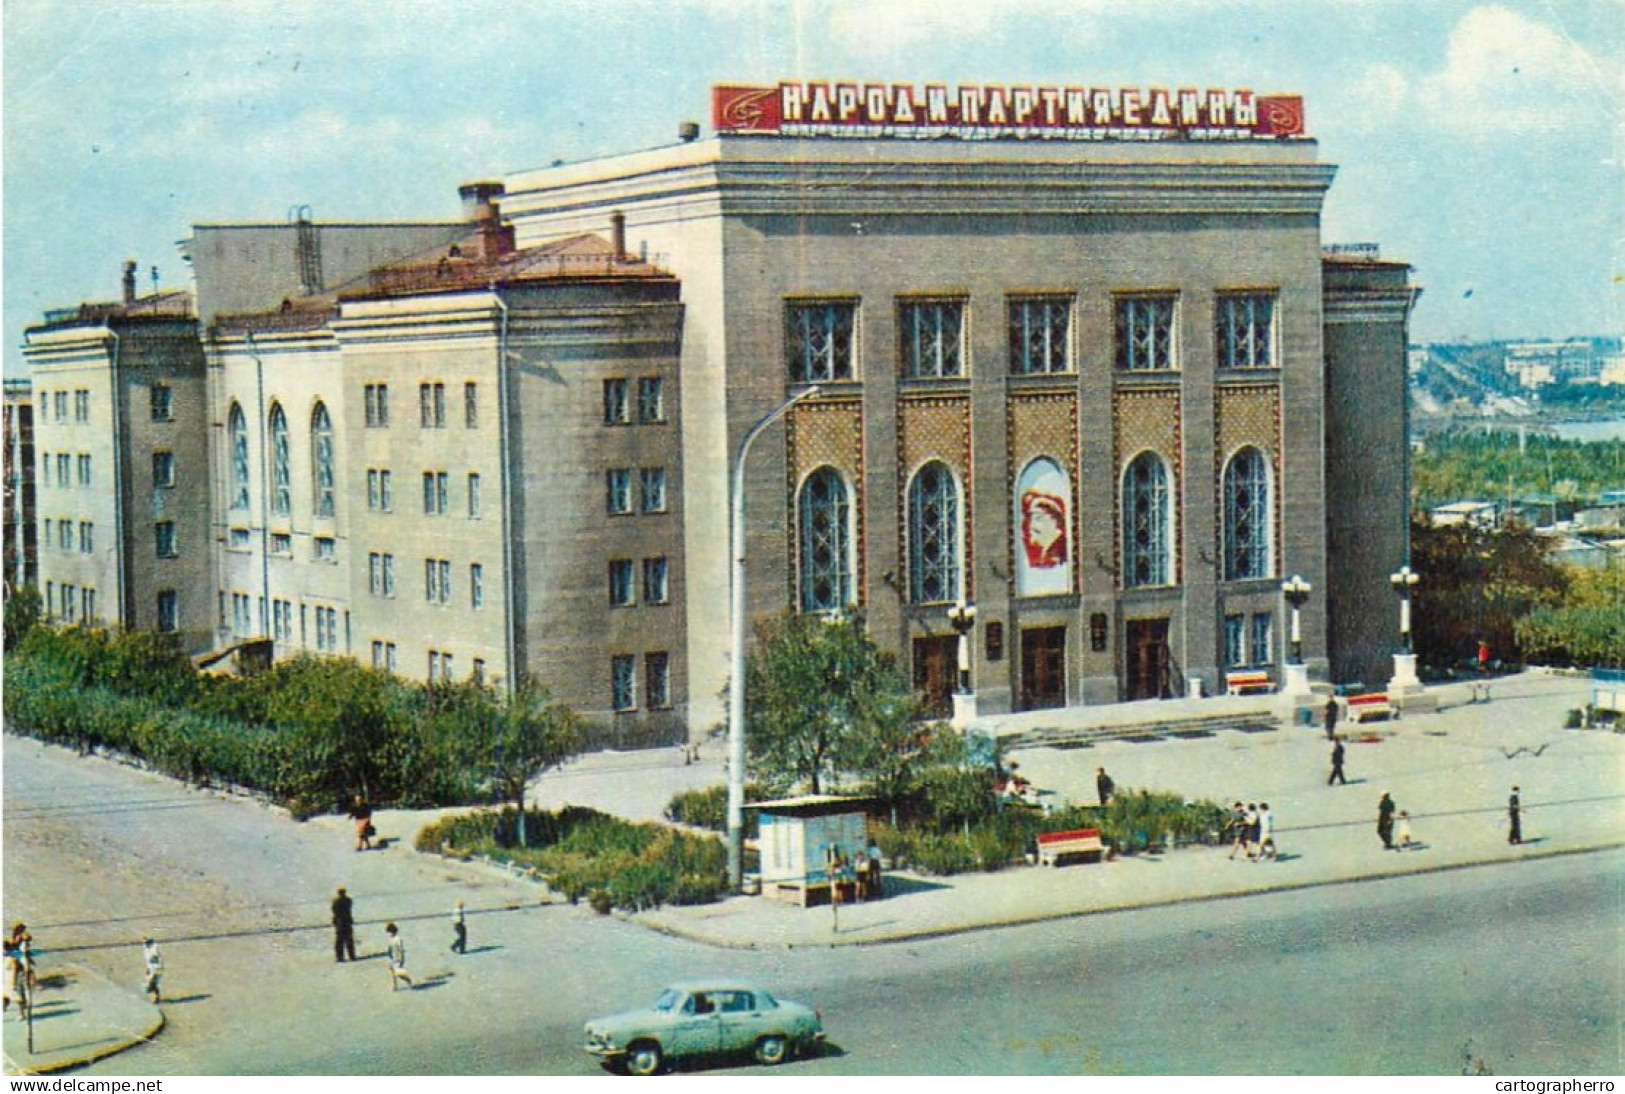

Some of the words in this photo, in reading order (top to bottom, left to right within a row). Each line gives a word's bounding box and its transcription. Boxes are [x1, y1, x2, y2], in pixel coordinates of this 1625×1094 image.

[782, 84, 916, 122] НАРОД
[926, 86, 948, 122] И
[960, 87, 1112, 124] ПАРТИЯ
[1122, 91, 1258, 126] ЕДИНЫ
